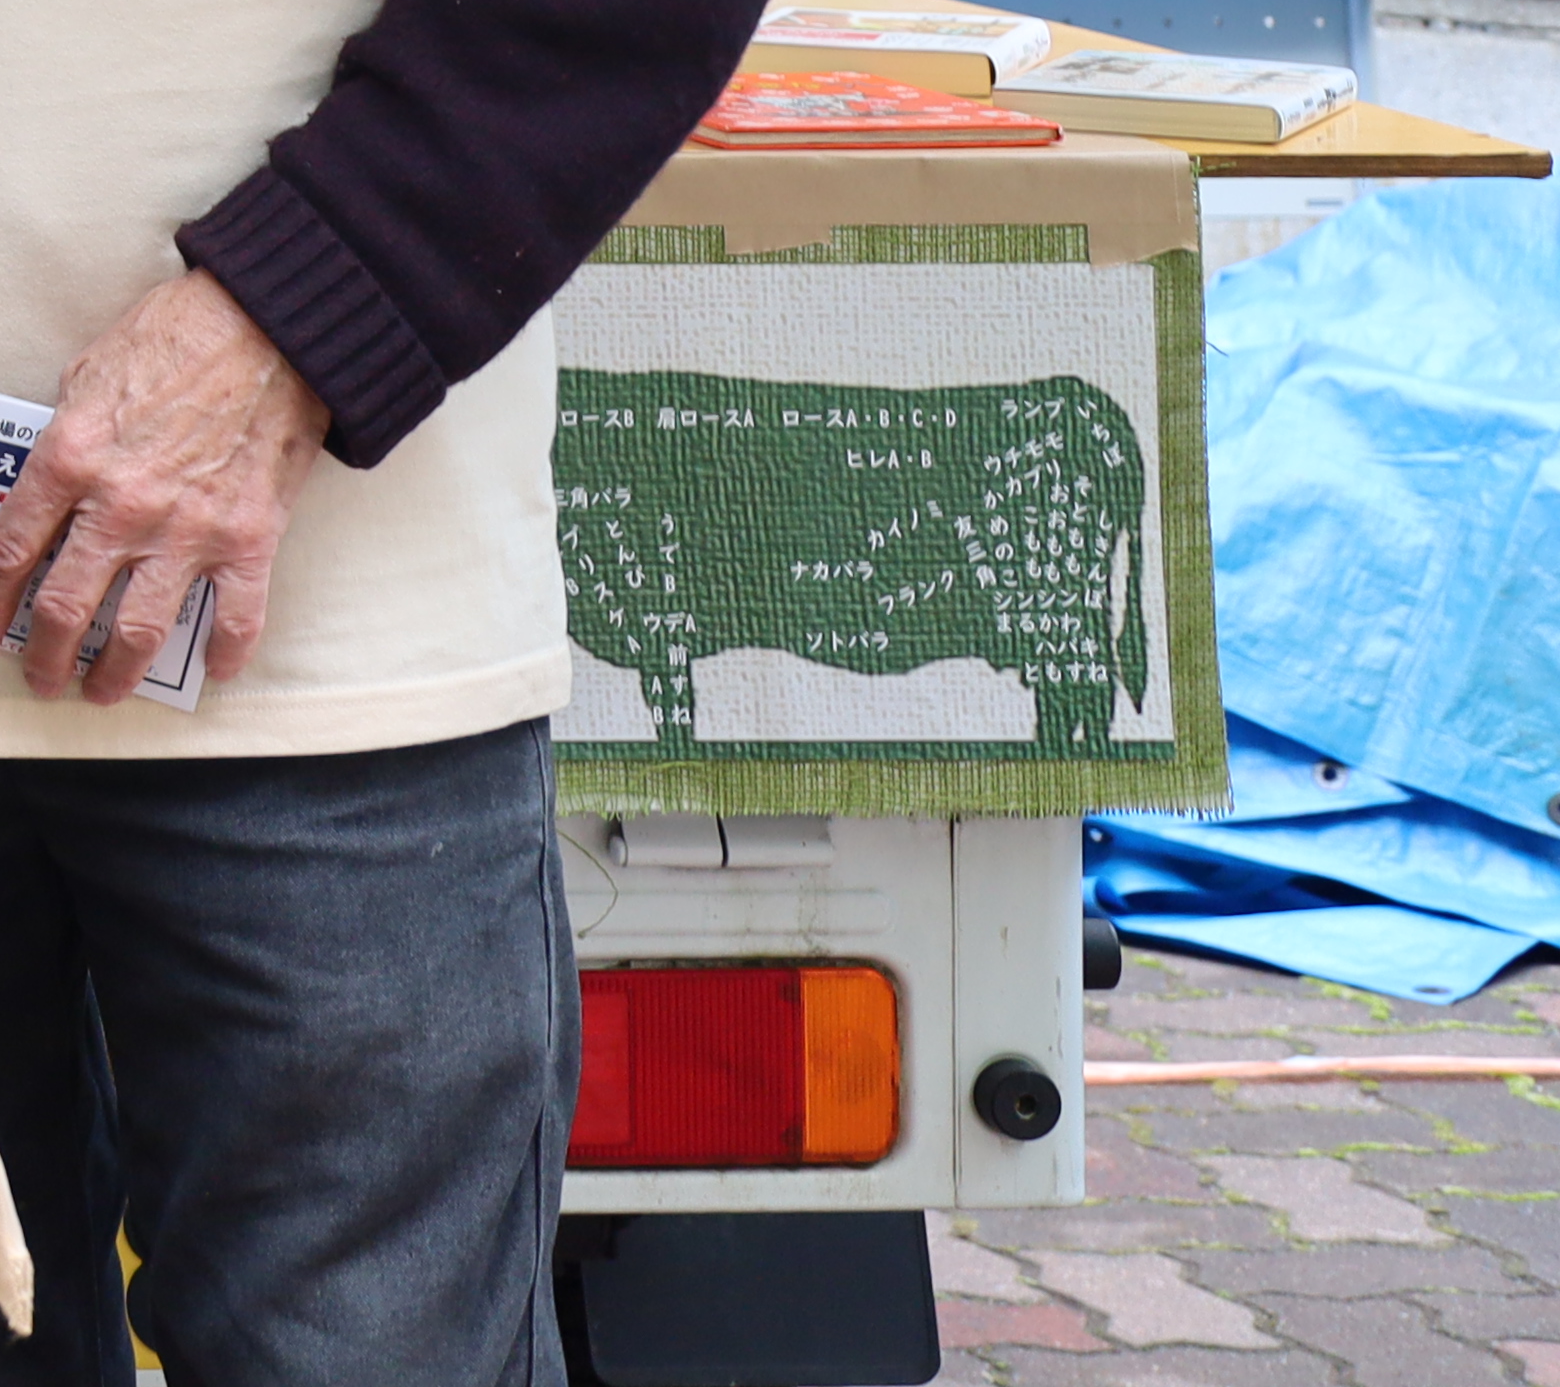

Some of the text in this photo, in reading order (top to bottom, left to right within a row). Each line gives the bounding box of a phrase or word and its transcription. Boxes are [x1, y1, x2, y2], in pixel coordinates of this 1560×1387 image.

[657, 407, 755, 430] 肩ロースA
[1001, 397, 1065, 420] ランプ
[984, 432, 1064, 476] ウチモモ
[868, 500, 944, 552] カイノミ
[984, 490, 1018, 588] かめのこ
[791, 560, 874, 582] ナカバラ
[878, 569, 954, 615] フランク
[643, 611, 696, 633] ウデA
[997, 612, 1081, 634] まるかわ
[806, 630, 890, 653] ソトバラ
[1025, 661, 1109, 683] ともすね
